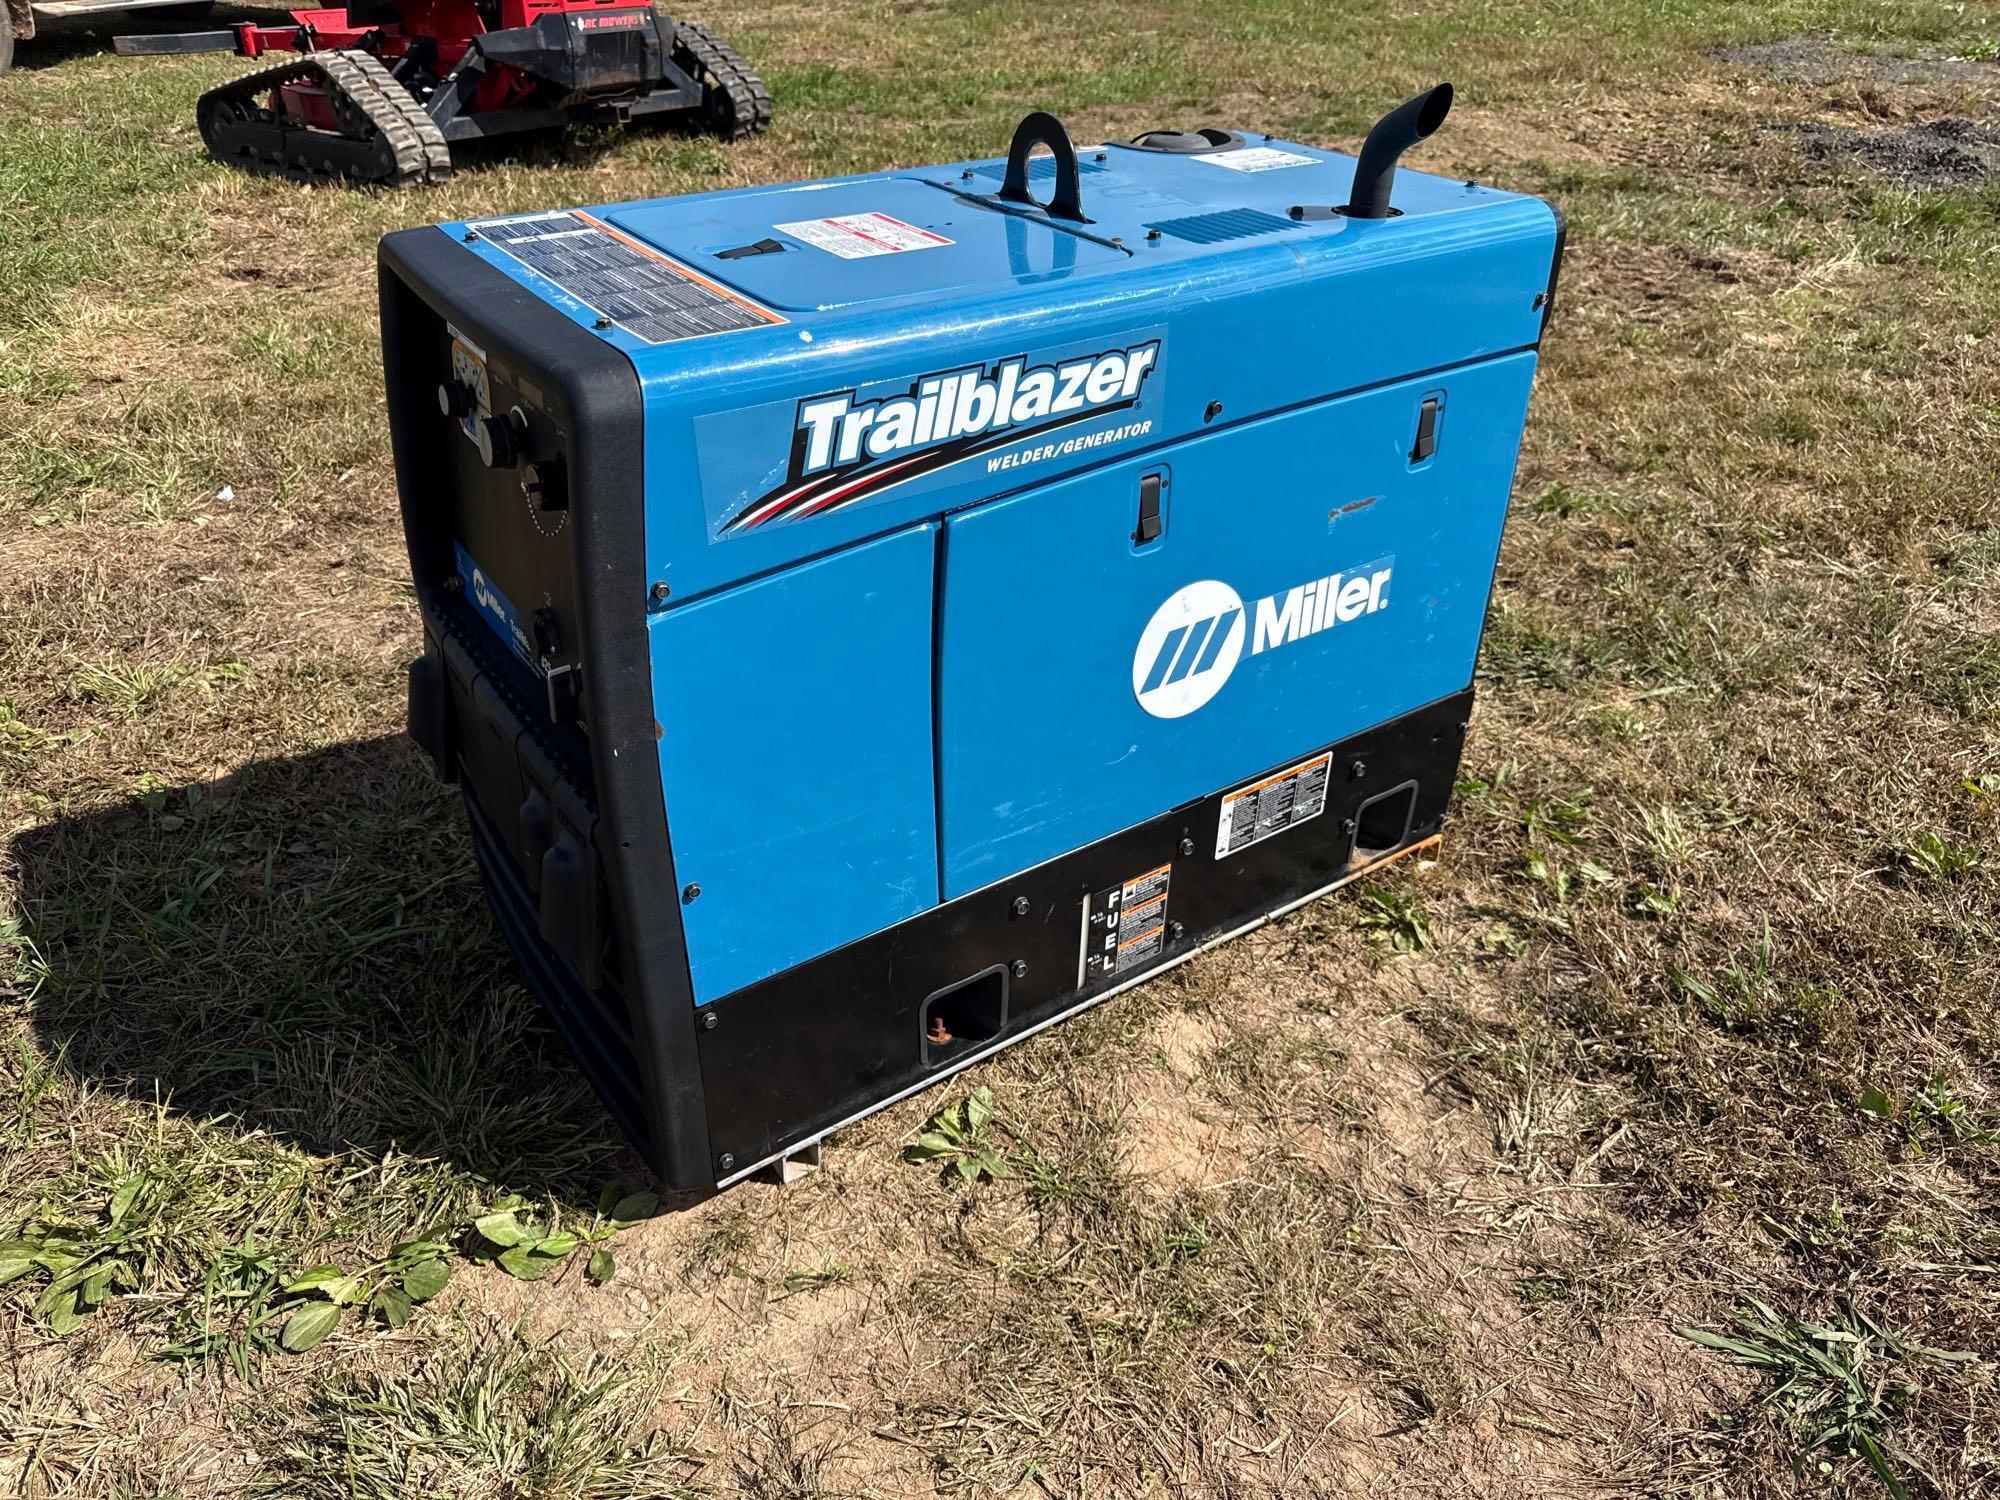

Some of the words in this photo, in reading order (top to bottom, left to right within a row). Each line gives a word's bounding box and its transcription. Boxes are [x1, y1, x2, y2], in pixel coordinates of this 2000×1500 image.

[799, 344, 1157, 471] Trailblazer
[987, 419, 1153, 473] WELDER/GENERATOR
[1251, 567, 1392, 656] Miller
[1103, 889, 1121, 971] FUEL
